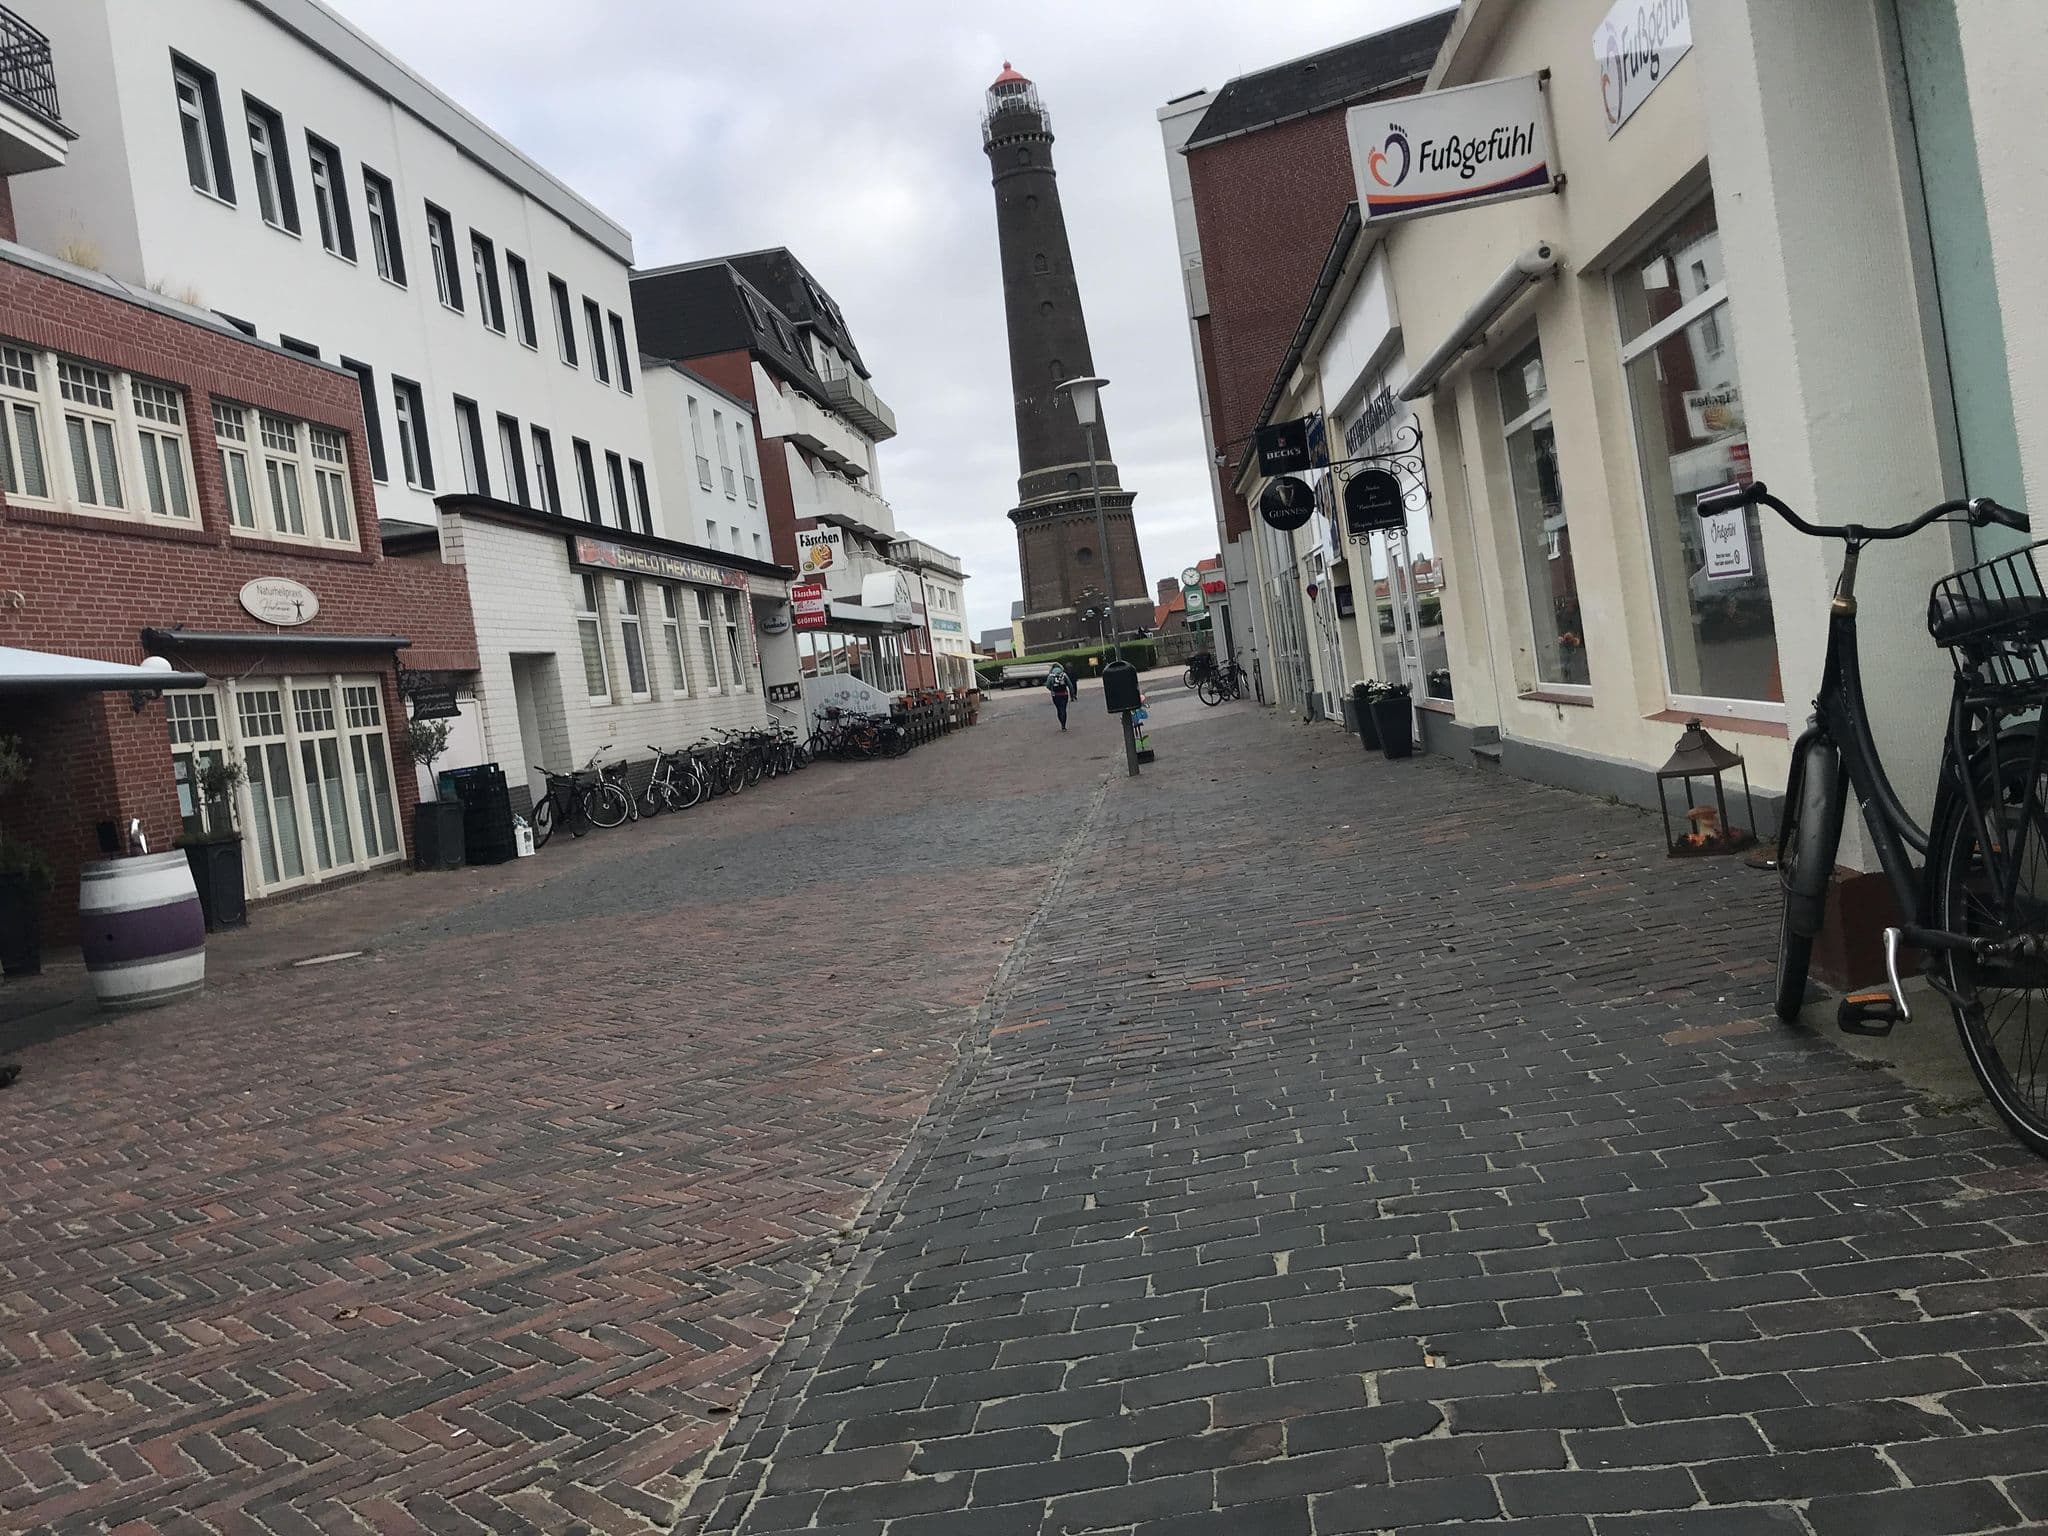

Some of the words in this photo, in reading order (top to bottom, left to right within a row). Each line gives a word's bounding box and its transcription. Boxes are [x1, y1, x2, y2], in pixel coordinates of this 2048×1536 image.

[1419, 122, 1535, 179] Fußgefühl
[800, 531, 840, 548] Fässchen
[617, 549, 687, 578] SPIELOTHEK
[691, 564, 722, 583] ROYAL
